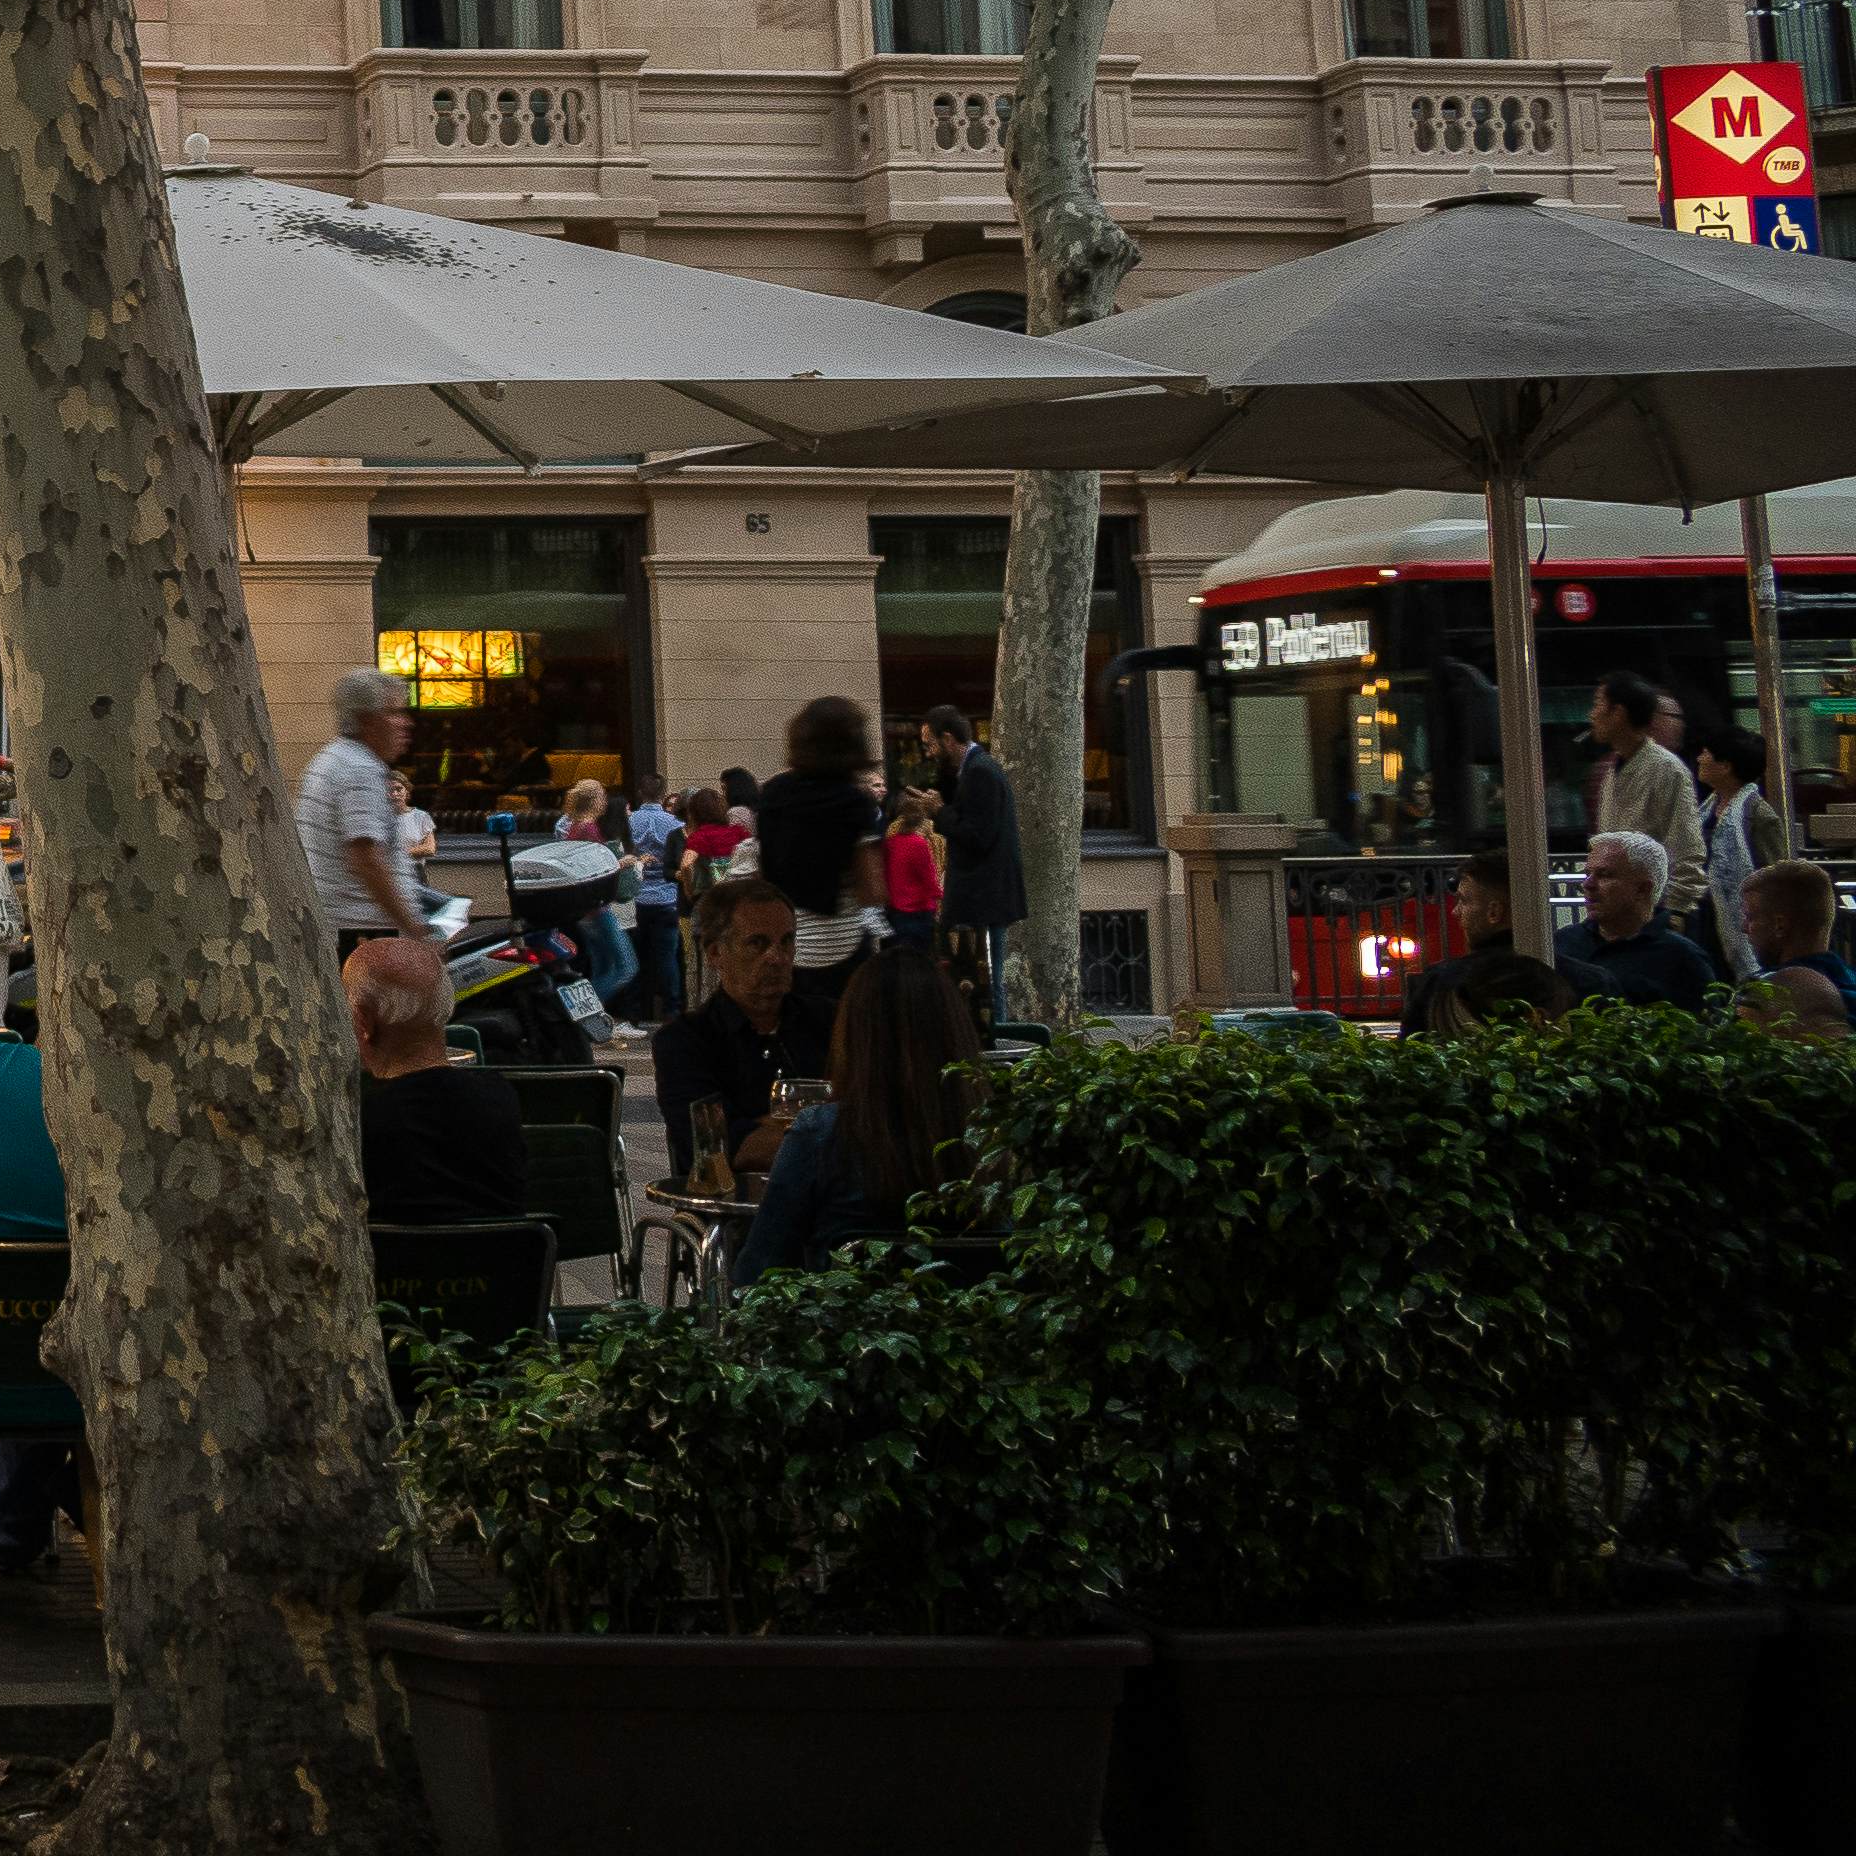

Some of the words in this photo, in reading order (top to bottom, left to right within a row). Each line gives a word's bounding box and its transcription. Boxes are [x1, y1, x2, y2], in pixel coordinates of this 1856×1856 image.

[1711, 95, 1763, 139] M
[1772, 159, 1801, 171] TMB
[745, 512, 770, 533] 65
